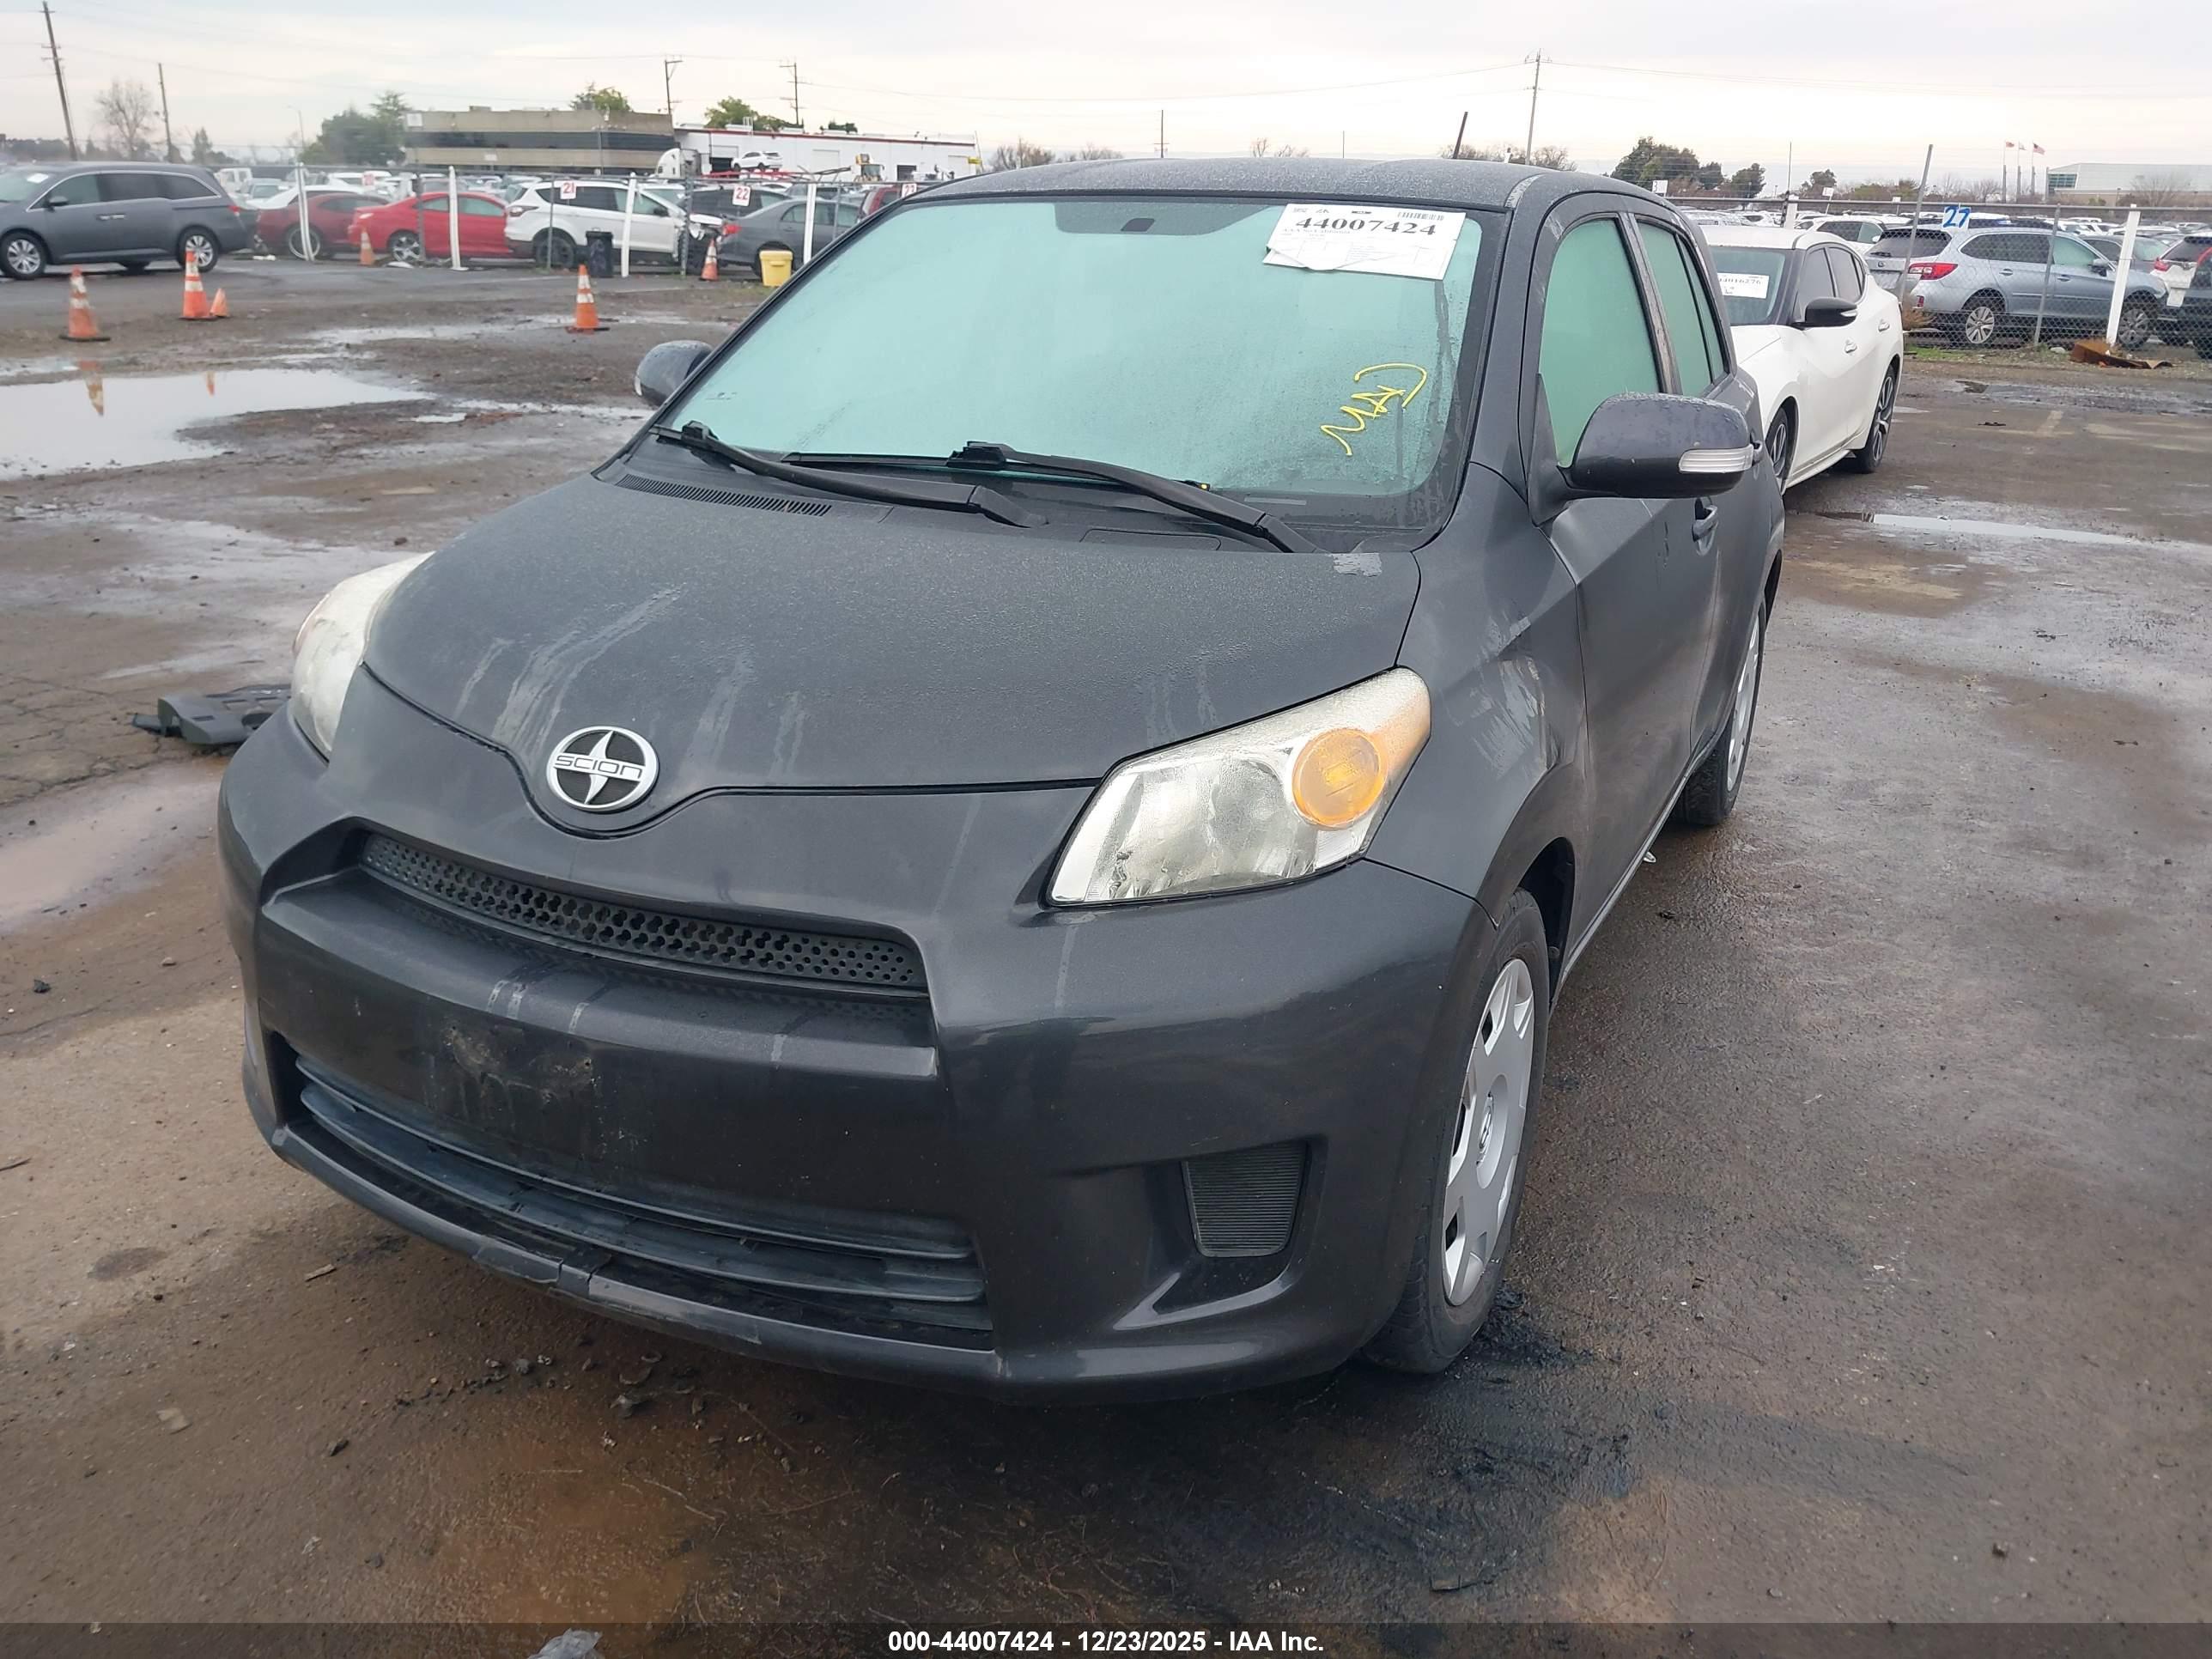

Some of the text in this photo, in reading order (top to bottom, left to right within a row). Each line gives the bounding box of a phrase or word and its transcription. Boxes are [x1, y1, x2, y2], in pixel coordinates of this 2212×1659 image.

[562, 181, 574, 194] 21
[735, 186, 750, 200] 22
[1942, 205, 1971, 228] 27
[1295, 216, 1437, 236] 44007424
